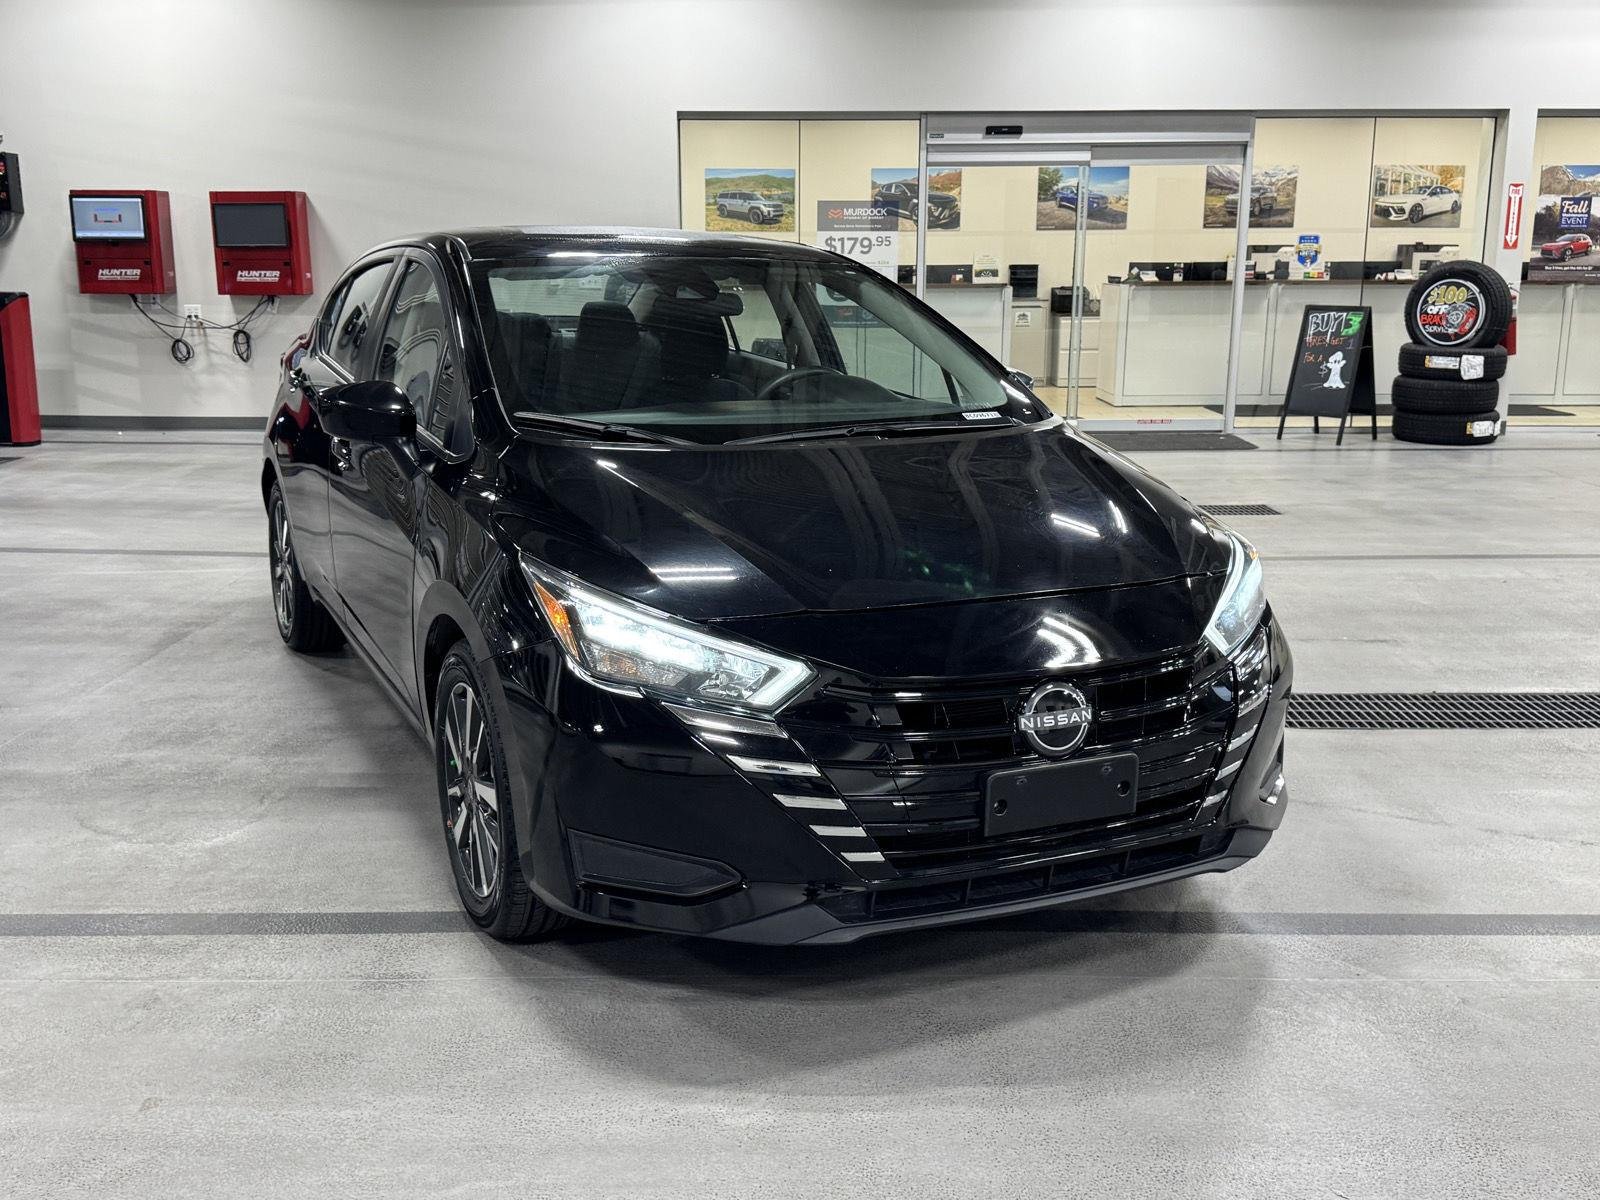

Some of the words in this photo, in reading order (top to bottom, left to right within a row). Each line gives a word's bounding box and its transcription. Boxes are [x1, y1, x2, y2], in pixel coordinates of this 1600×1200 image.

[843, 207, 888, 216] MURDOCK
[1562, 200, 1589, 213] Fall
[1561, 217, 1588, 225] EVENT
[824, 235, 892, 255] $179.95
[98, 268, 141, 277] HUNTER
[237, 270, 280, 278] HUNTER
[1427, 285, 1468, 305] $100
[1307, 311, 1347, 340] BUY
[1341, 311, 1364, 336] 3
[1020, 708, 1092, 729] NISSAN
